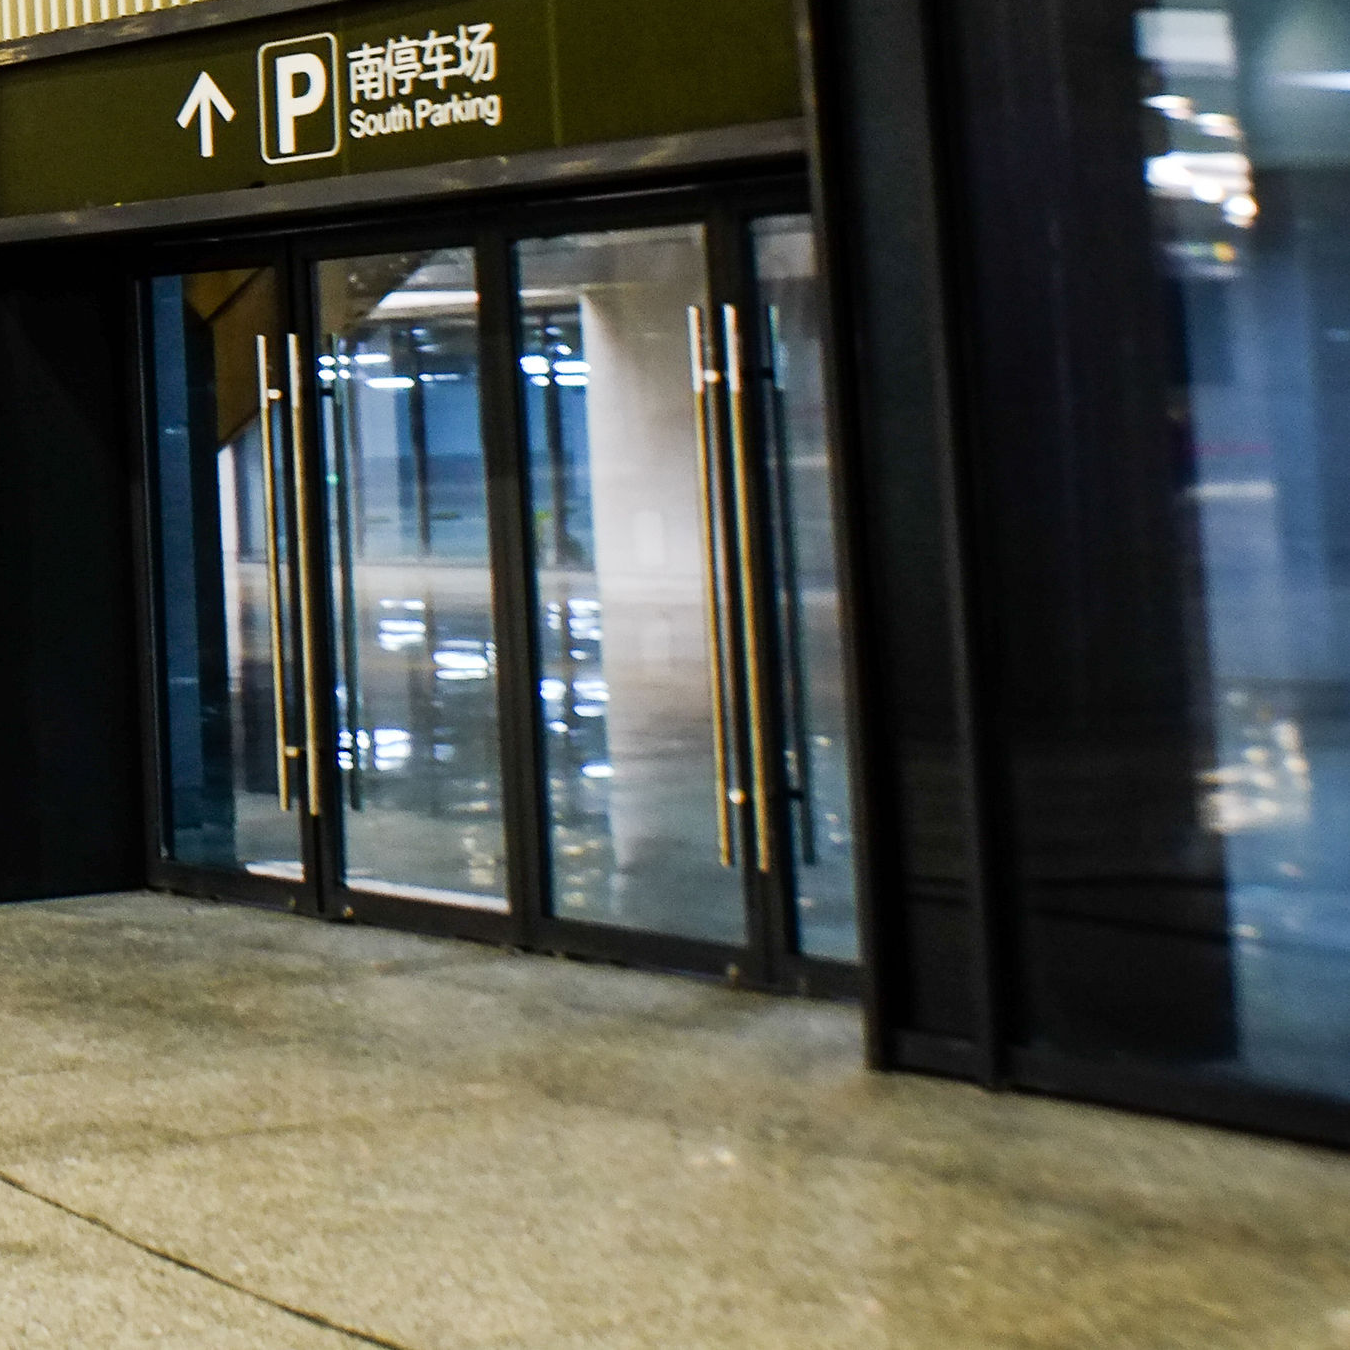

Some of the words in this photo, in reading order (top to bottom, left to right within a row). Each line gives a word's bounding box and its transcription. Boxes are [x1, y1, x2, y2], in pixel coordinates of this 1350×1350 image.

[275, 52, 327, 154] P
[347, 22, 497, 104] 南停车场
[349, 102, 413, 139] South
[414, 91, 502, 129] Parking
